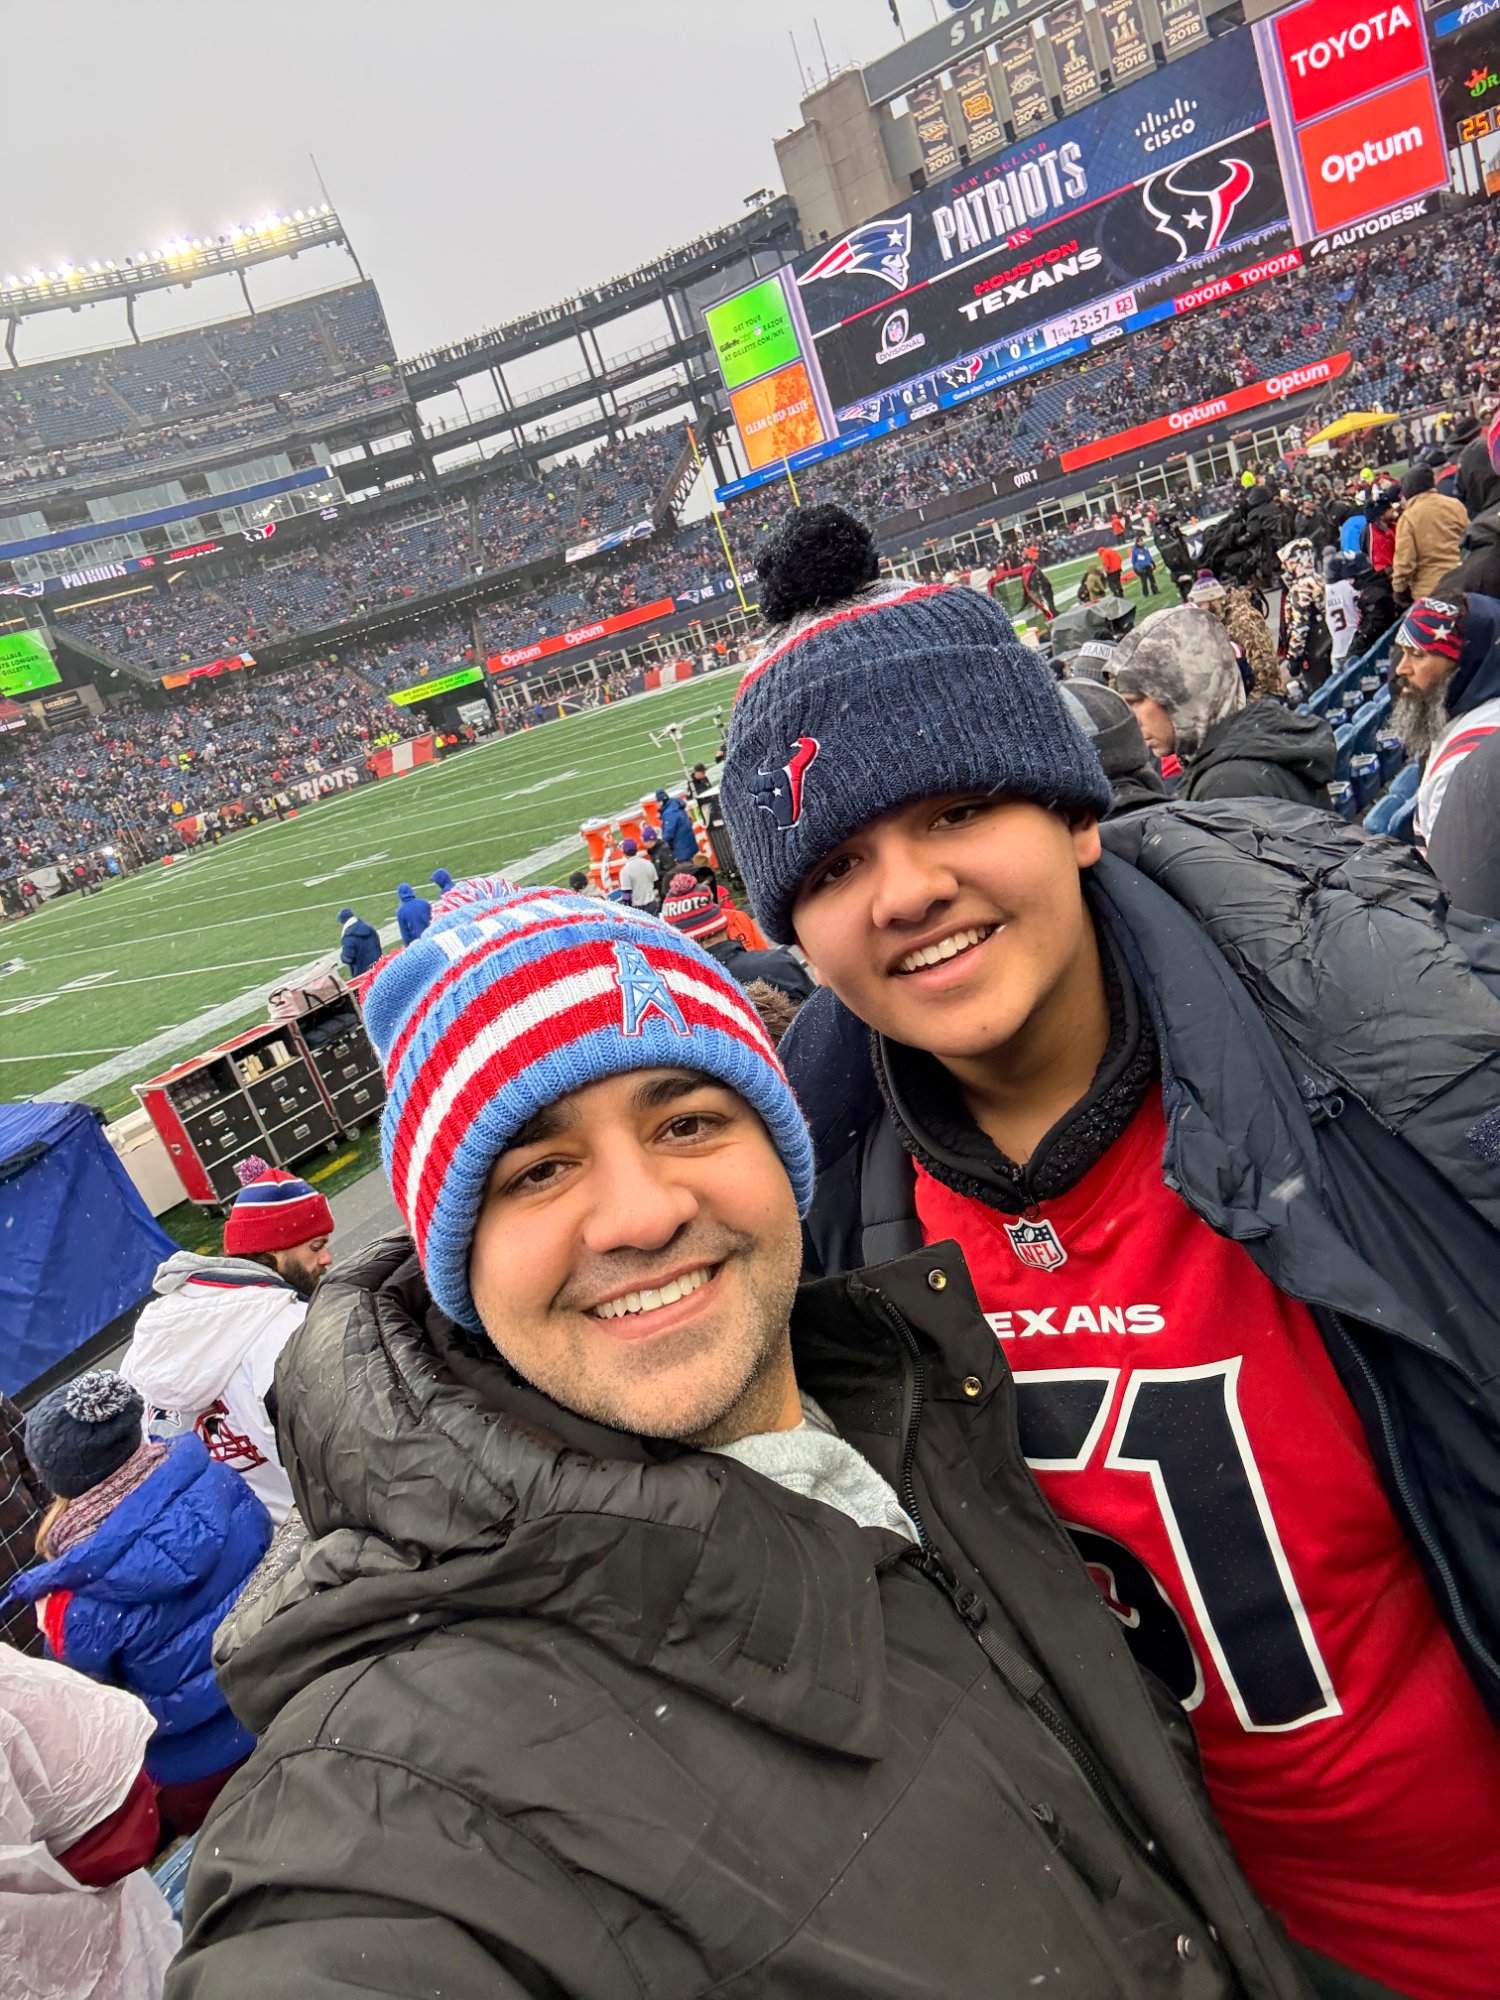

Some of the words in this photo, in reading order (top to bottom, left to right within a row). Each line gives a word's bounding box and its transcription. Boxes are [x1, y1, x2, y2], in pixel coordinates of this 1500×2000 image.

[951, 0, 1032, 46] STA
[1169, 22, 1200, 46] 2018
[1290, 5, 1411, 77] TOYOTA
[1063, 55, 1088, 75] XLIX
[1116, 51, 1147, 74] 2016
[1066, 78, 1096, 101] 2014
[1470, 73, 1500, 97] DR
[971, 128, 1000, 150] 2003
[1144, 119, 1195, 152] CISCO
[928, 152, 955, 173] 2001
[1321, 125, 1423, 183] Optum
[952, 176, 978, 194] NEW
[983, 143, 1047, 180] ENGLAND
[932, 141, 1088, 261] PATRIOTS
[1332, 199, 1428, 250] AUTODESK
[973, 240, 1079, 296] HOUSTON
[958, 247, 1103, 322] TEXANS
[1176, 281, 1232, 310] TOYOTA
[1240, 253, 1299, 285] TOYOTA
[1071, 305, 1110, 335] 25:57
[880, 339, 922, 361] DIVISIONAL
[1010, 343, 1021, 359] 0
[1266, 362, 1330, 395] Optum
[903, 390, 913, 405] 0
[745, 418, 768, 436] CLEAN
[786, 400, 809, 417] TASTE
[1168, 400, 1227, 429] Optum
[1013, 471, 1032, 488] QTR
[1031, 469, 1038, 480] 1
[700, 586, 715, 599] NE
[1330, 608, 1347, 632] 3
[565, 625, 605, 645] Optum
[501, 646, 541, 666] Optum
[661, 896, 709, 918] TRIOTS
[1019, 1242, 1059, 1265] NFL
[983, 1303, 1166, 1339] EXANS
